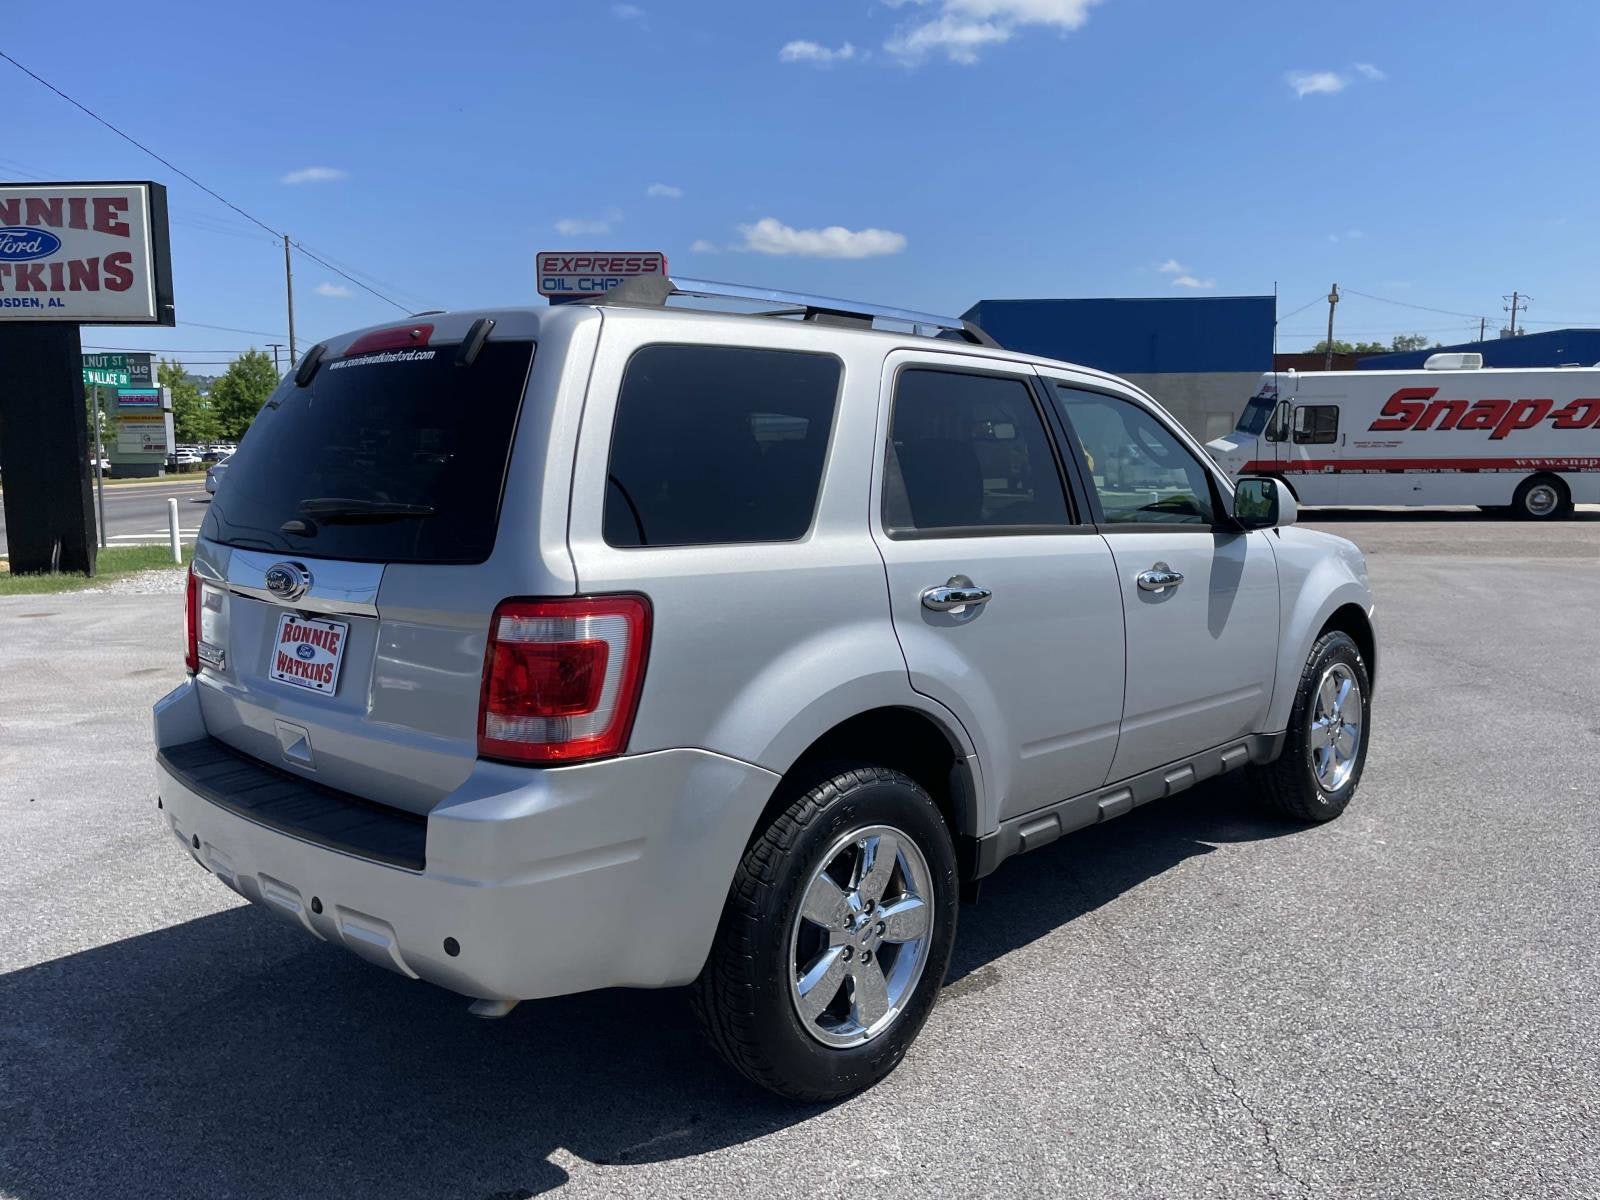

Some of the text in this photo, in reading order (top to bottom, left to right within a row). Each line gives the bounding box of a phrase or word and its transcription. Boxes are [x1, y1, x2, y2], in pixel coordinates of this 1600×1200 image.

[543, 257, 659, 272] EXPRESS
[542, 278, 624, 291] OIL CHA
[0, 298, 65, 310] SDEN, AL
[112, 355, 122, 366] ST
[329, 350, 436, 371] www.ronniewatkinsford.com
[88, 370, 118, 385] WALLACE
[1367, 387, 1600, 440] Snap-o
[281, 623, 340, 656] RONNIE
[276, 650, 334, 684] WATKINS
